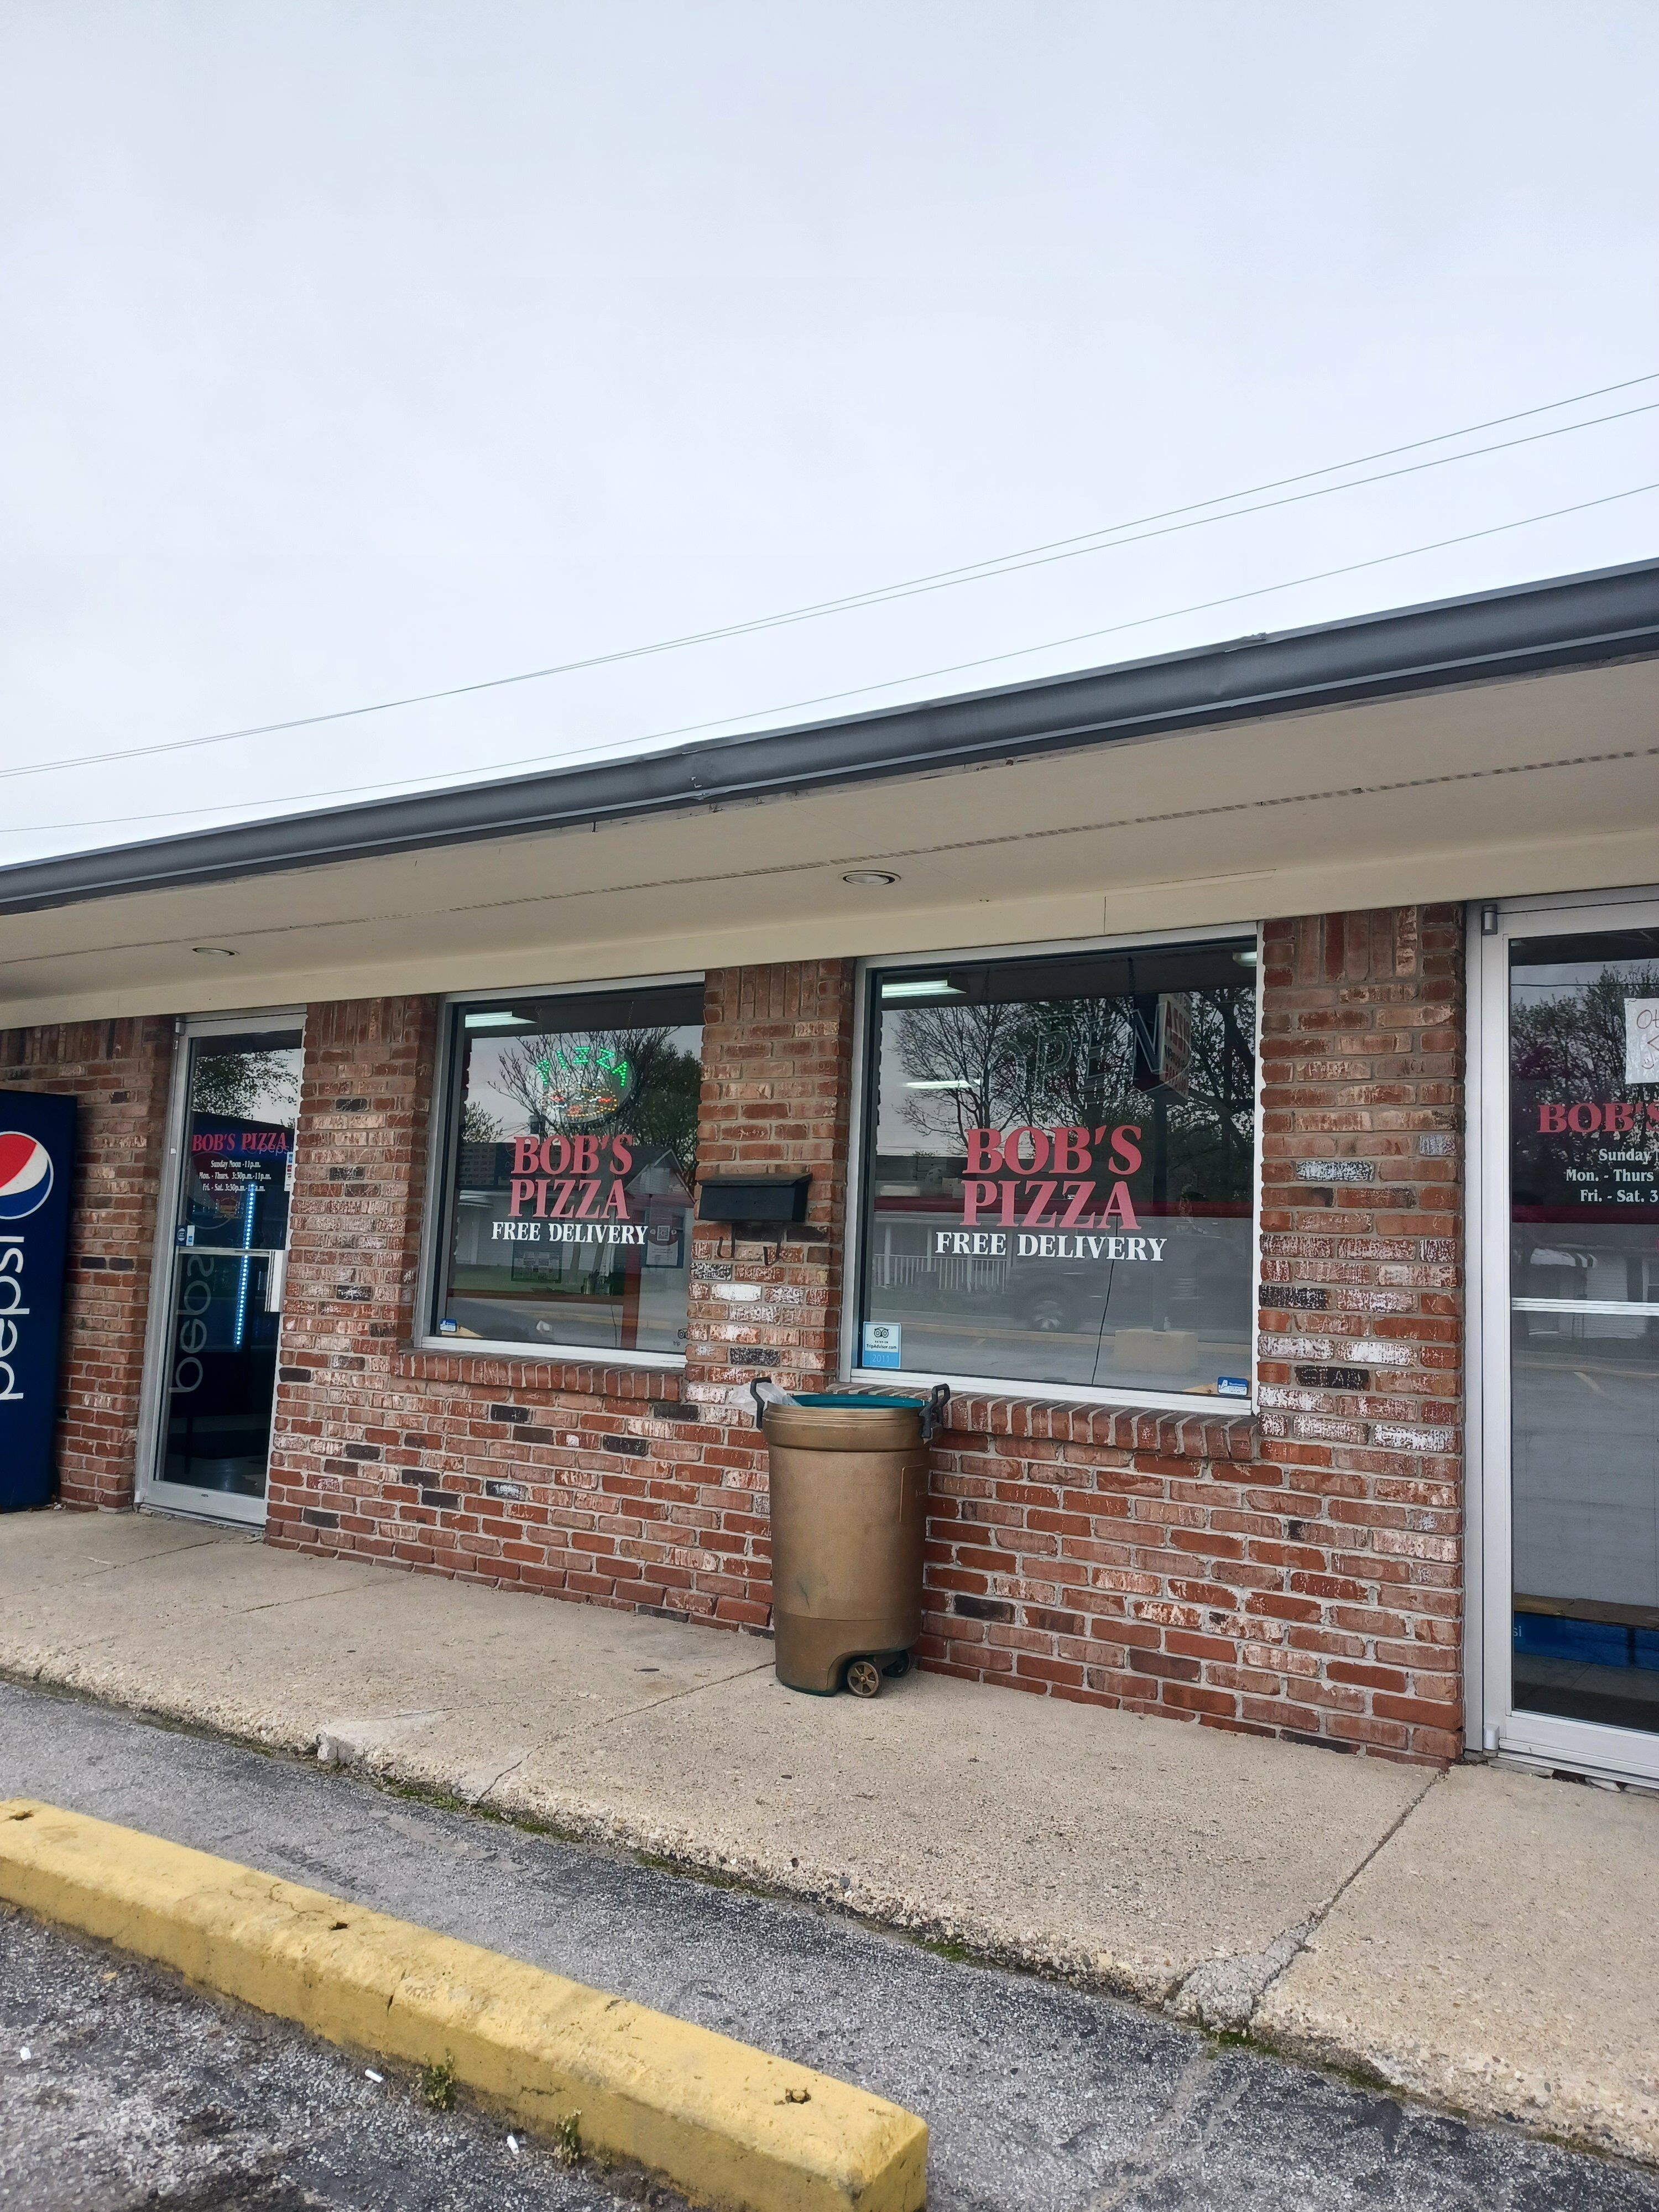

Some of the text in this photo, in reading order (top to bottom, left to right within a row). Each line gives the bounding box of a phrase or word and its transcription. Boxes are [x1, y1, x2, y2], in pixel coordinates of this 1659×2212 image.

[535, 1046, 628, 1087] PIZZA
[192, 1133, 286, 1151] BOB'S PIZZA
[962, 1125, 1142, 1175] BOB'S
[211, 1160, 228, 1169] Sunday
[510, 1134, 633, 1175] BOB'S
[1598, 1147, 1650, 1164] Sunday
[1566, 1169, 1599, 1181] Mon.
[1613, 1169, 1654, 1181] Thurs
[507, 1179, 630, 1219] PIZZA
[959, 1180, 1142, 1230] PIZZA
[1580, 1190, 1602, 1202] Fri.
[1617, 1190, 1645, 1202] Sat.
[491, 1222, 649, 1245] FREE DELIVERY
[935, 1232, 1167, 1261] FREE DELIVERY
[872, 1354, 889, 1363] 2011
